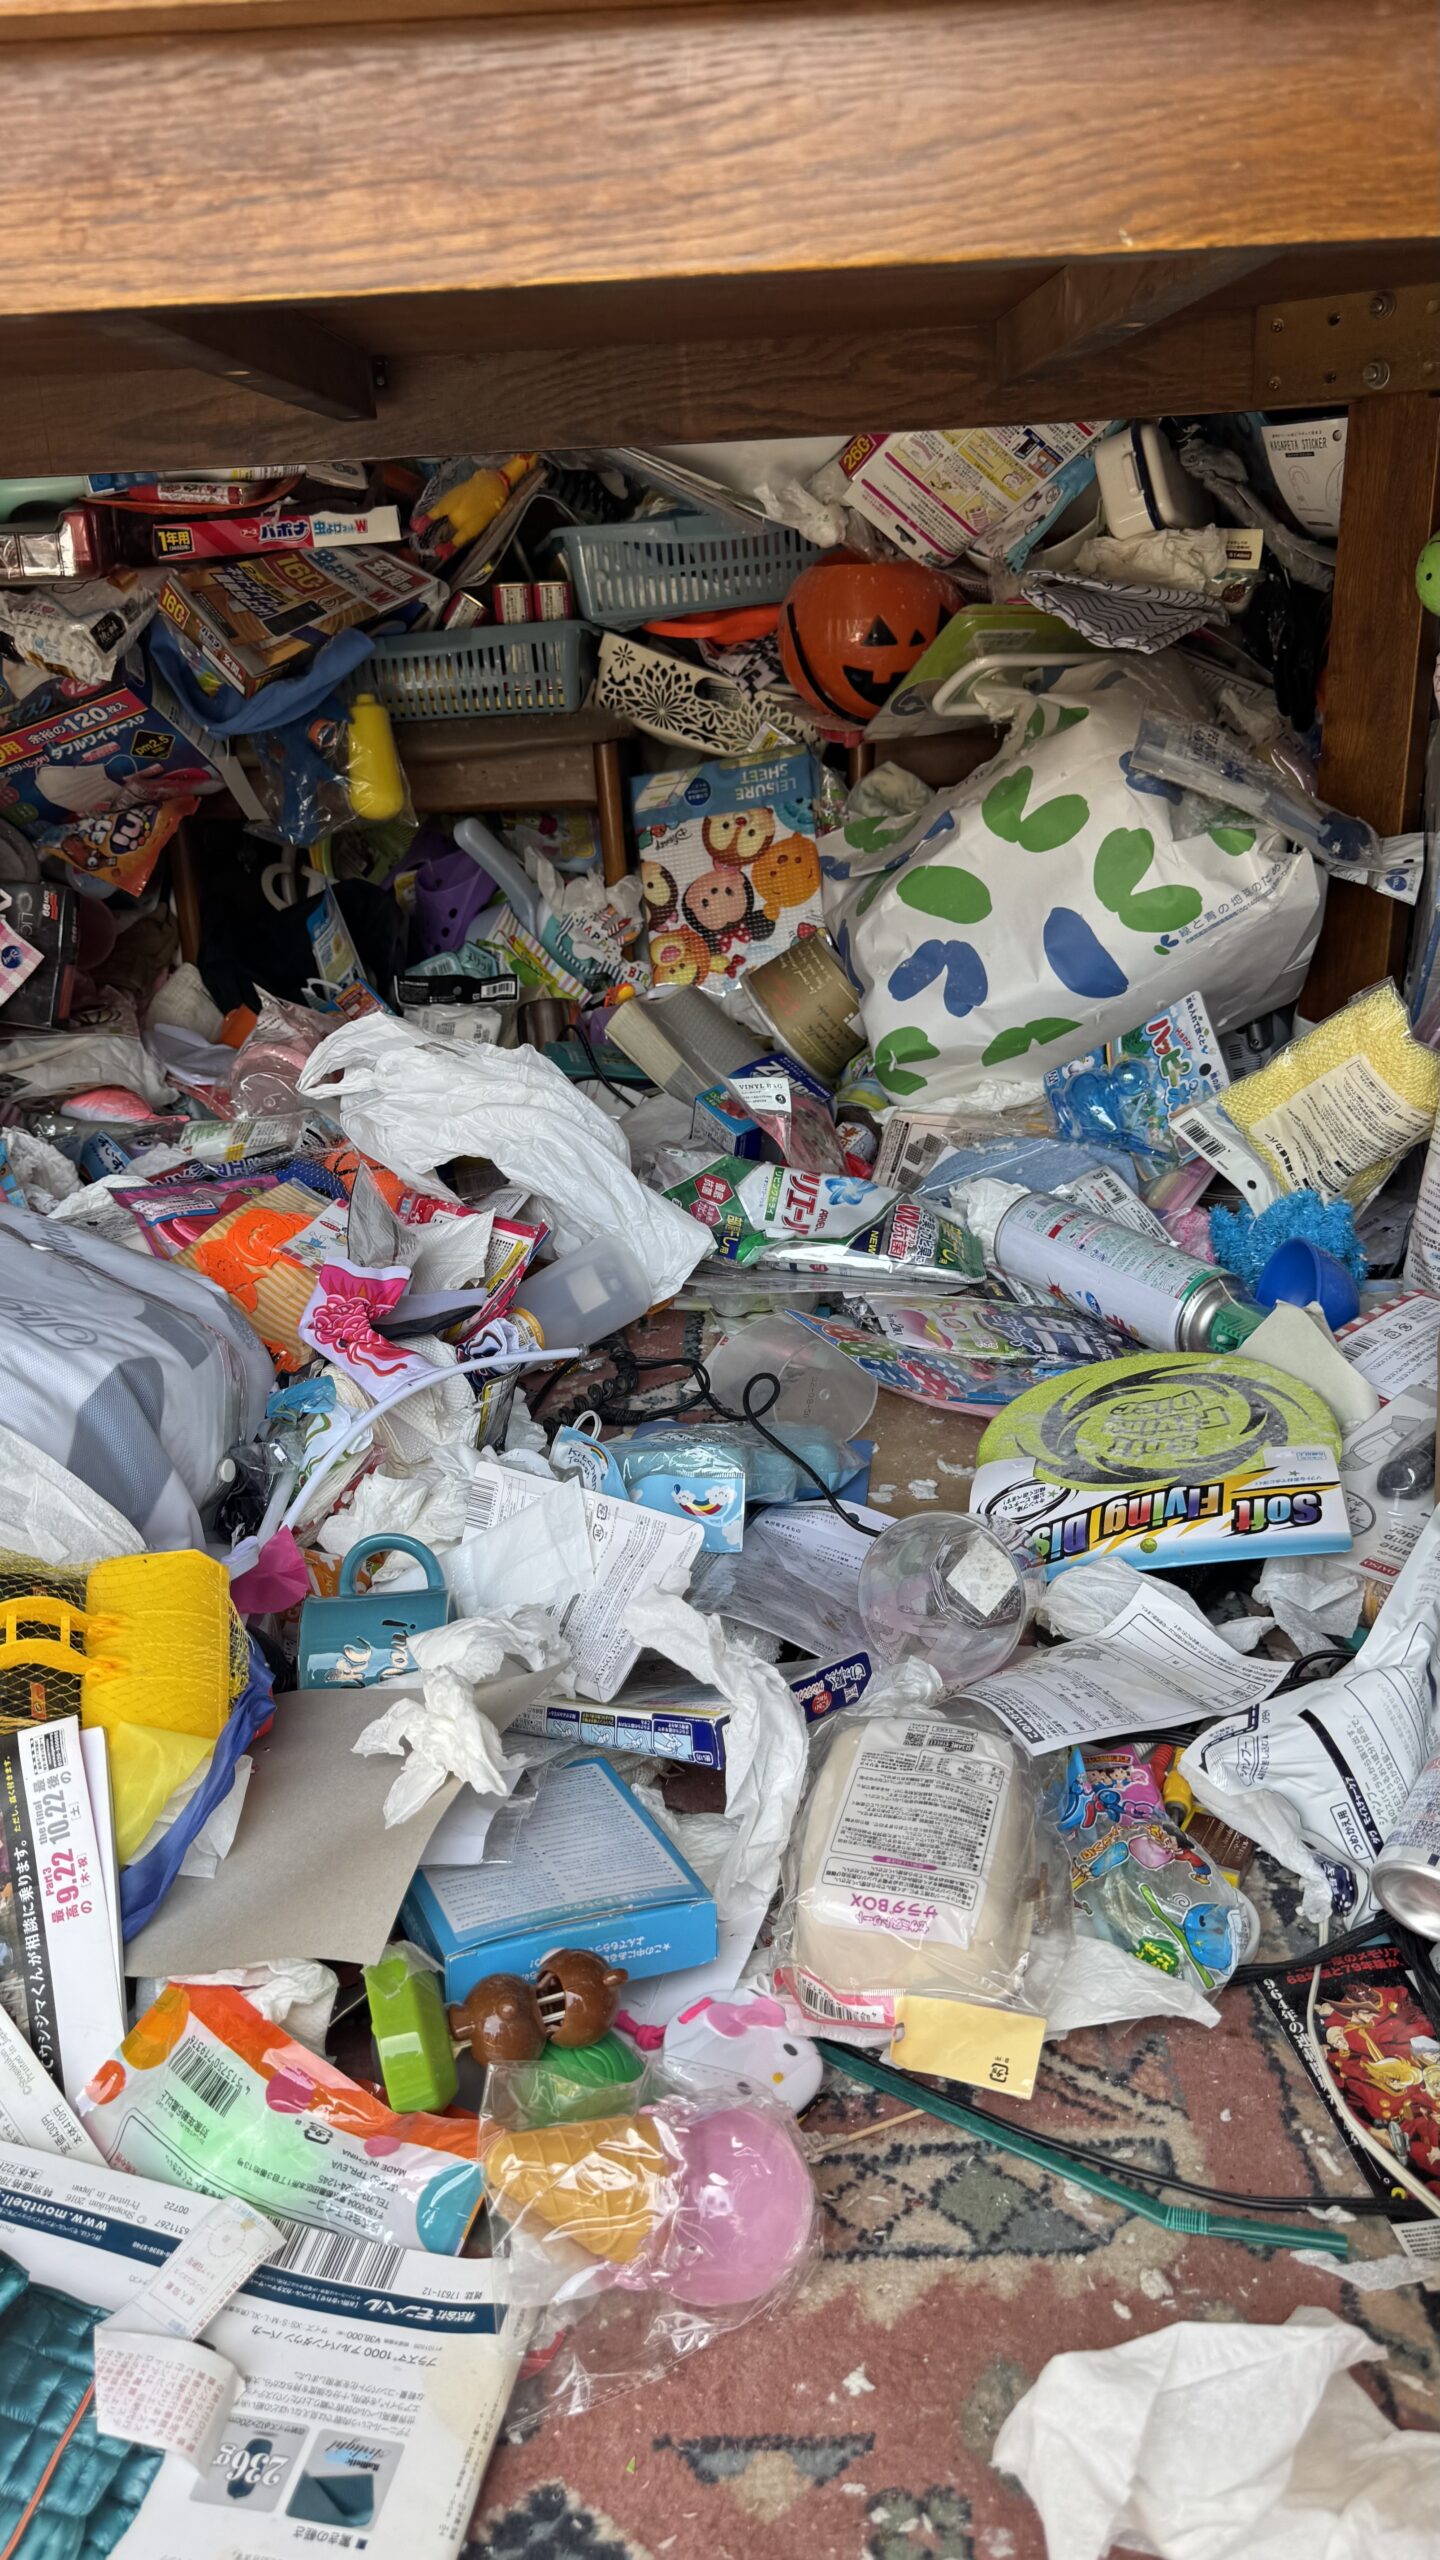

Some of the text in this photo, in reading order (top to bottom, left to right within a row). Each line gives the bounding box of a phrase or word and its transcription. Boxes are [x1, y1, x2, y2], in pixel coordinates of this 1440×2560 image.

[739, 763, 789, 785] SHEET
[735, 779, 797, 800] LEISURE
[813, 1209, 828, 1232] ARIEL
[865, 1229, 879, 1254] NEW
[1100, 1485, 1221, 1534] Flying
[1227, 1493, 1323, 1534] Soft
[1025, 1512, 1090, 1563] Dis
[32, 1799, 48, 1845] the Final
[41, 1789, 71, 1845] 10.22
[1335, 1807, 1364, 1854] つめかえ用
[49, 1847, 80, 1904] 9.22
[848, 1891, 938, 1921] サラダBOX
[51, 2103, 84, 2146] 本体410円
[341, 2148, 368, 2164] CHINA
[379, 2161, 407, 2176] MADE
[64, 2191, 85, 2206] 2016
[70, 2180, 96, 2198] Japan
[106, 2192, 140, 2211] Printed
[0, 2190, 107, 2233] www.montbell.
[163, 2199, 190, 2215] 00722
[154, 2217, 190, 2236] 6311267
[422, 2285, 460, 2300] 17631-12
[212, 2441, 290, 2487] 236g
